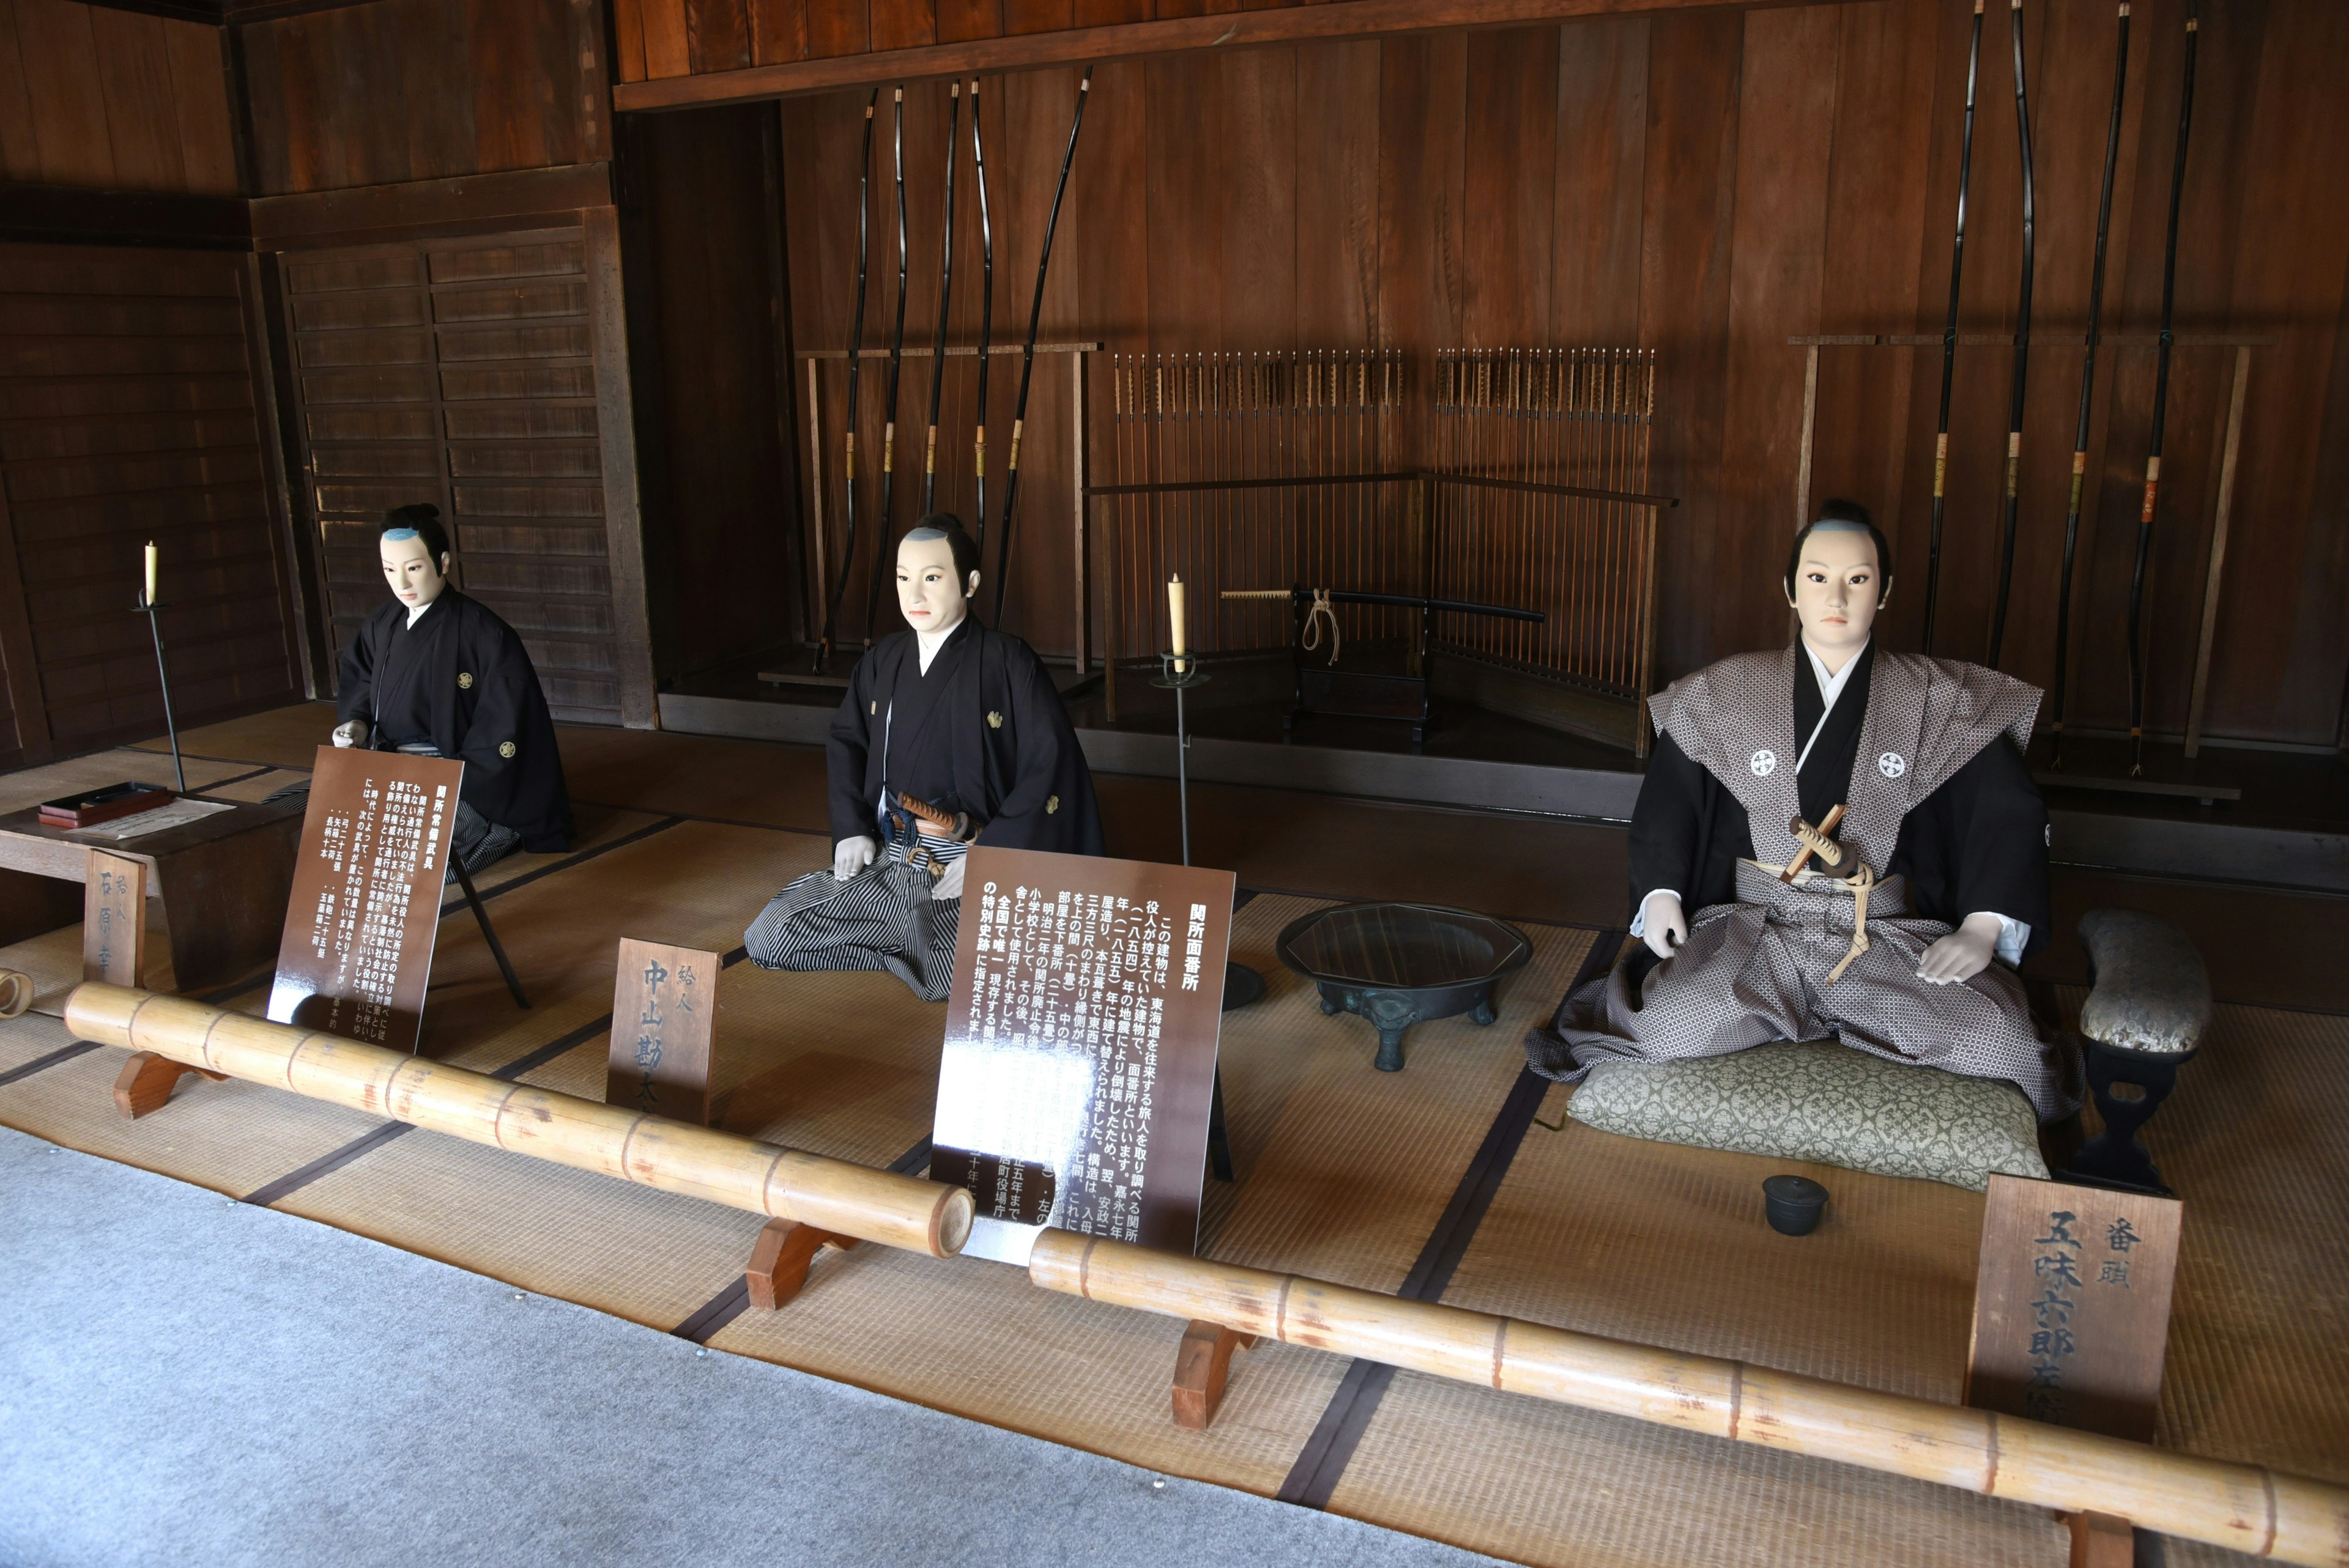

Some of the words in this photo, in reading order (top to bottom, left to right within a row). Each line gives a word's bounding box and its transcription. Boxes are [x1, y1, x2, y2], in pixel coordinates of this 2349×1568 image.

[423, 785, 447, 870] 関所常備武具
[676, 965, 697, 1012] 給人
[999, 886, 1028, 1036] 舎として使用されました。
[1181, 903, 1206, 991] 関所面番所
[634, 959, 668, 1114] 中山勘太
[2096, 1218, 2141, 1289] 番頭
